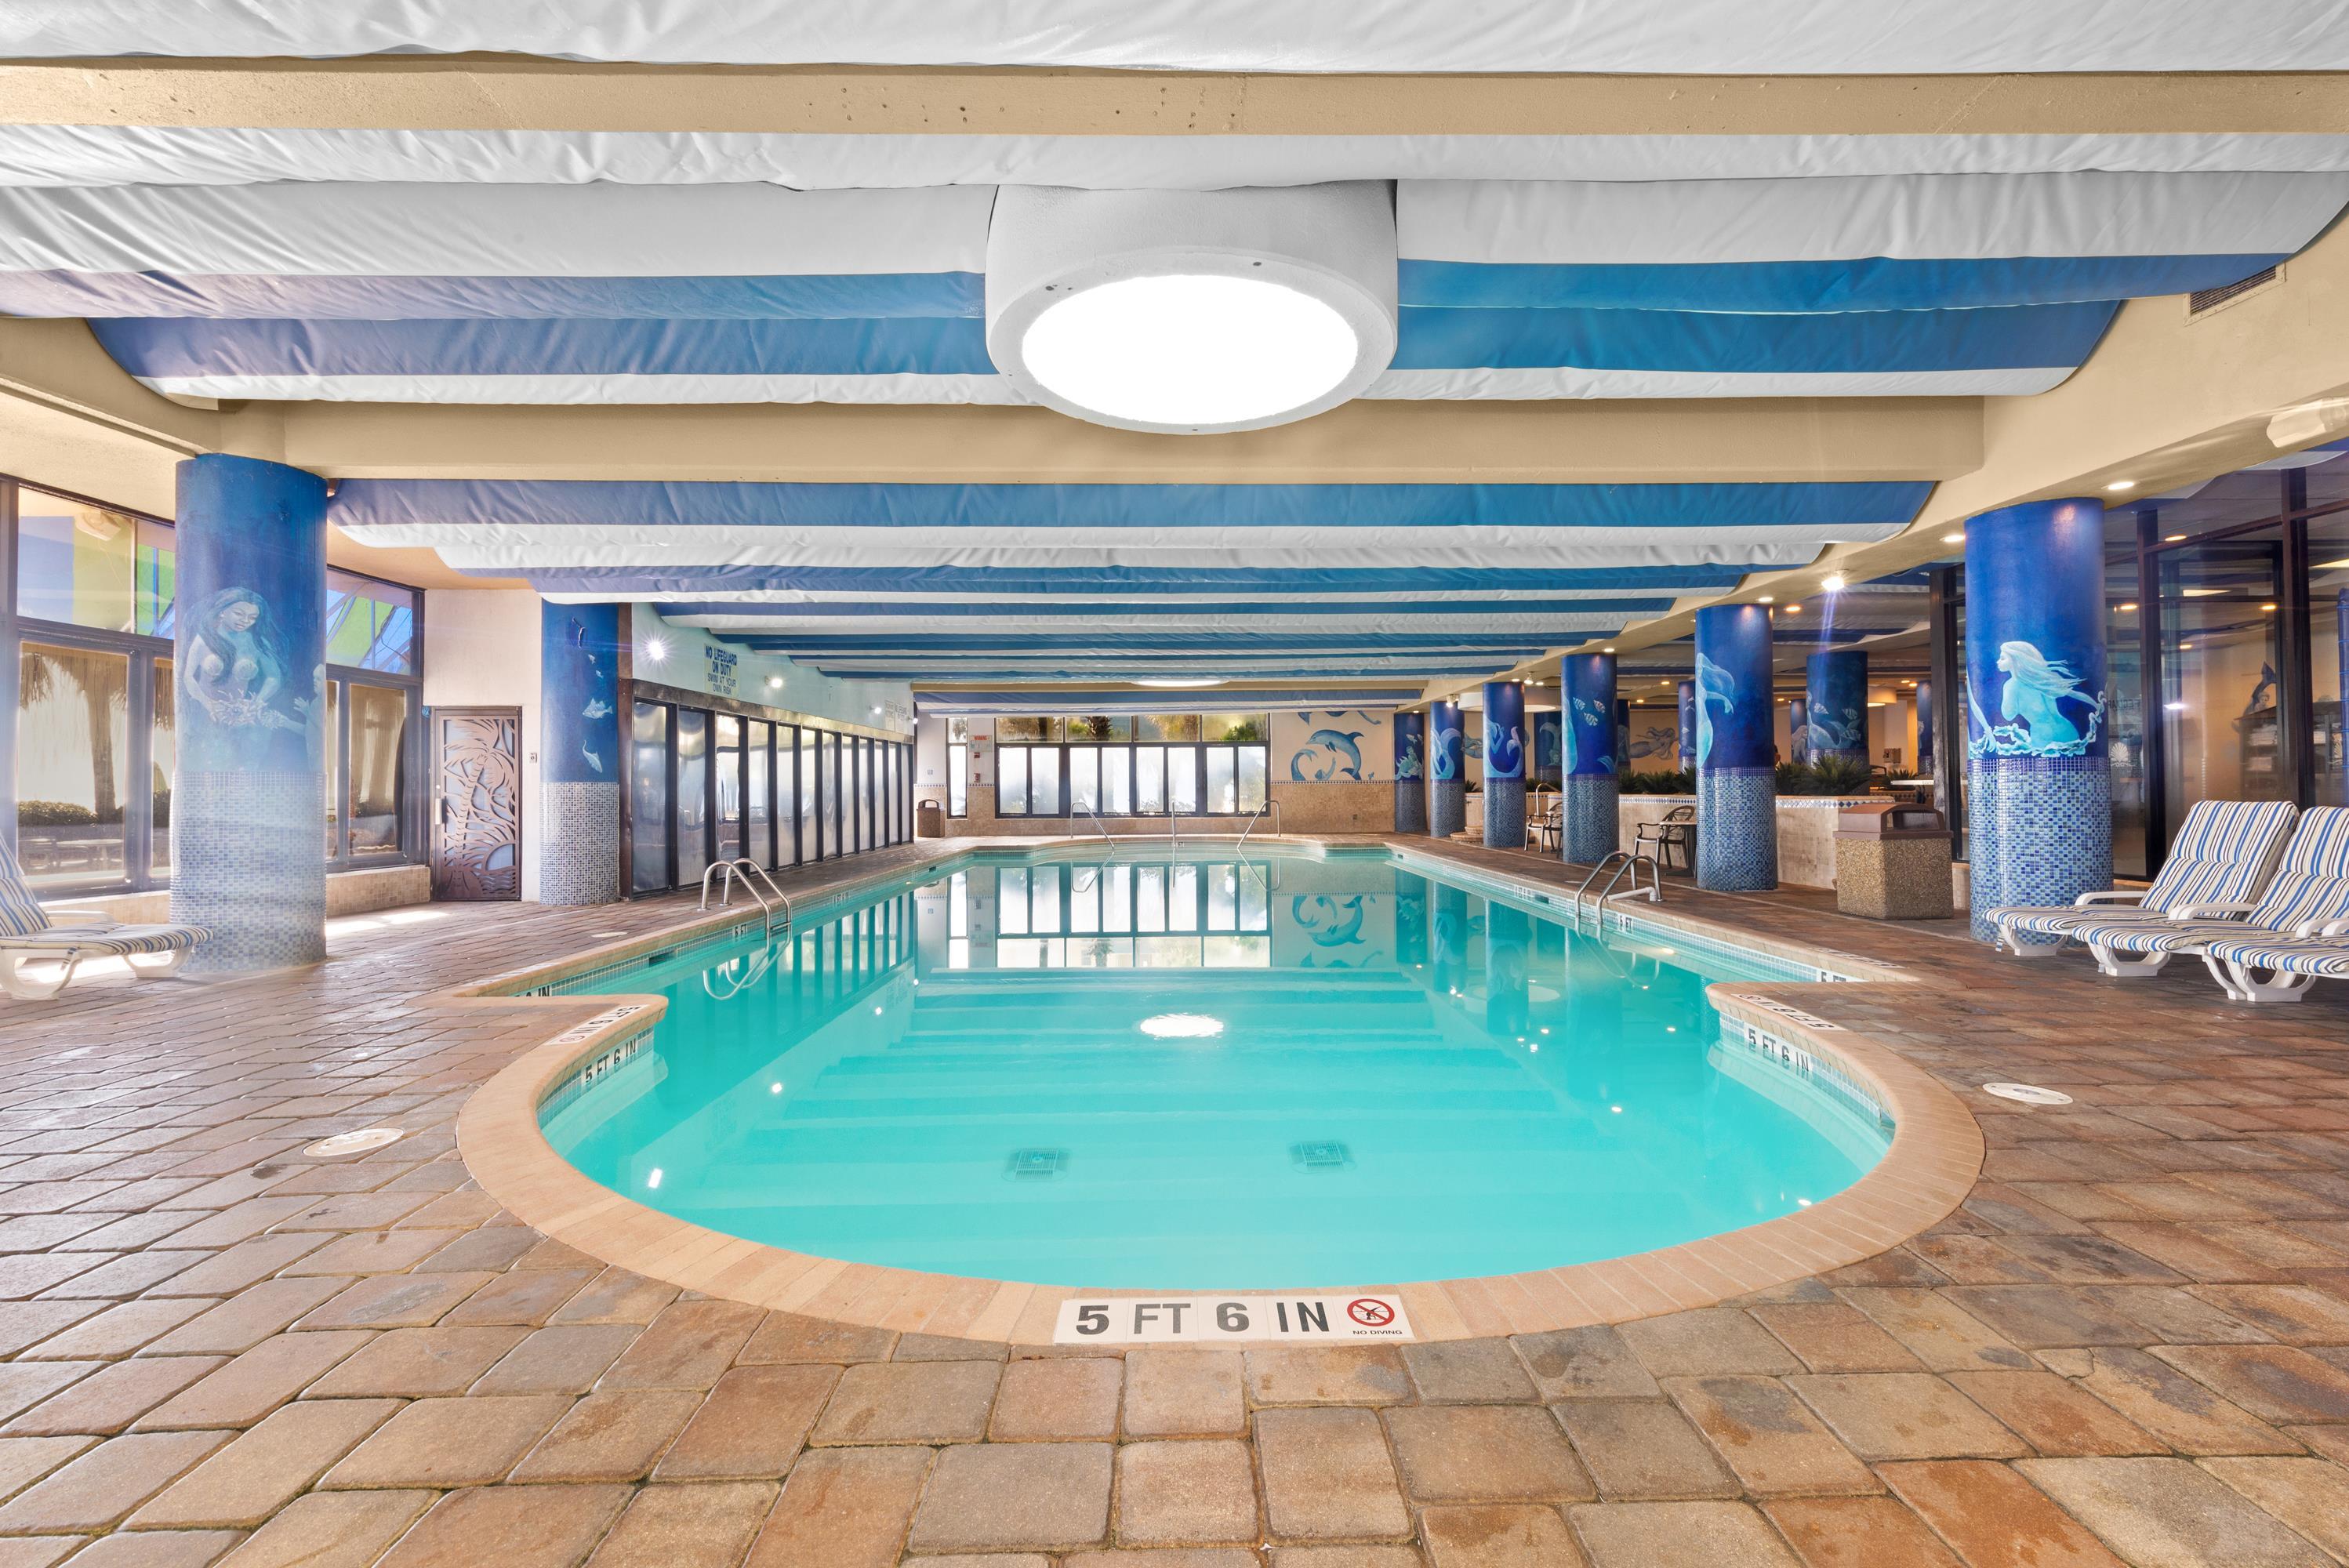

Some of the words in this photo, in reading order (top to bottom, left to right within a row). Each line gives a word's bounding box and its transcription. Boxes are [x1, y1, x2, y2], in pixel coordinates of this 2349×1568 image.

[706, 646, 712, 659] NO
[714, 648, 737, 666] LIFEGUARD
[713, 660, 718, 673] ON
[721, 663, 732, 677] DUTY
[708, 673, 717, 683] SWIM
[726, 677, 736, 688] YOUR
[586, 1065, 593, 1083] 5
[597, 1054, 609, 1076] FT
[613, 1048, 620, 1065] 6
[626, 1038, 637, 1058] IN
[1748, 1029, 1756, 1044] 5
[1762, 1035, 1777, 1054] FT
[1781, 1045, 1790, 1062] 6
[1795, 1051, 1809, 1072] IN
[1076, 1305, 1109, 1335] 5
[1134, 1303, 1191, 1334] FT
[1216, 1302, 1250, 1333] 6
[1276, 1302, 1330, 1333] IN
